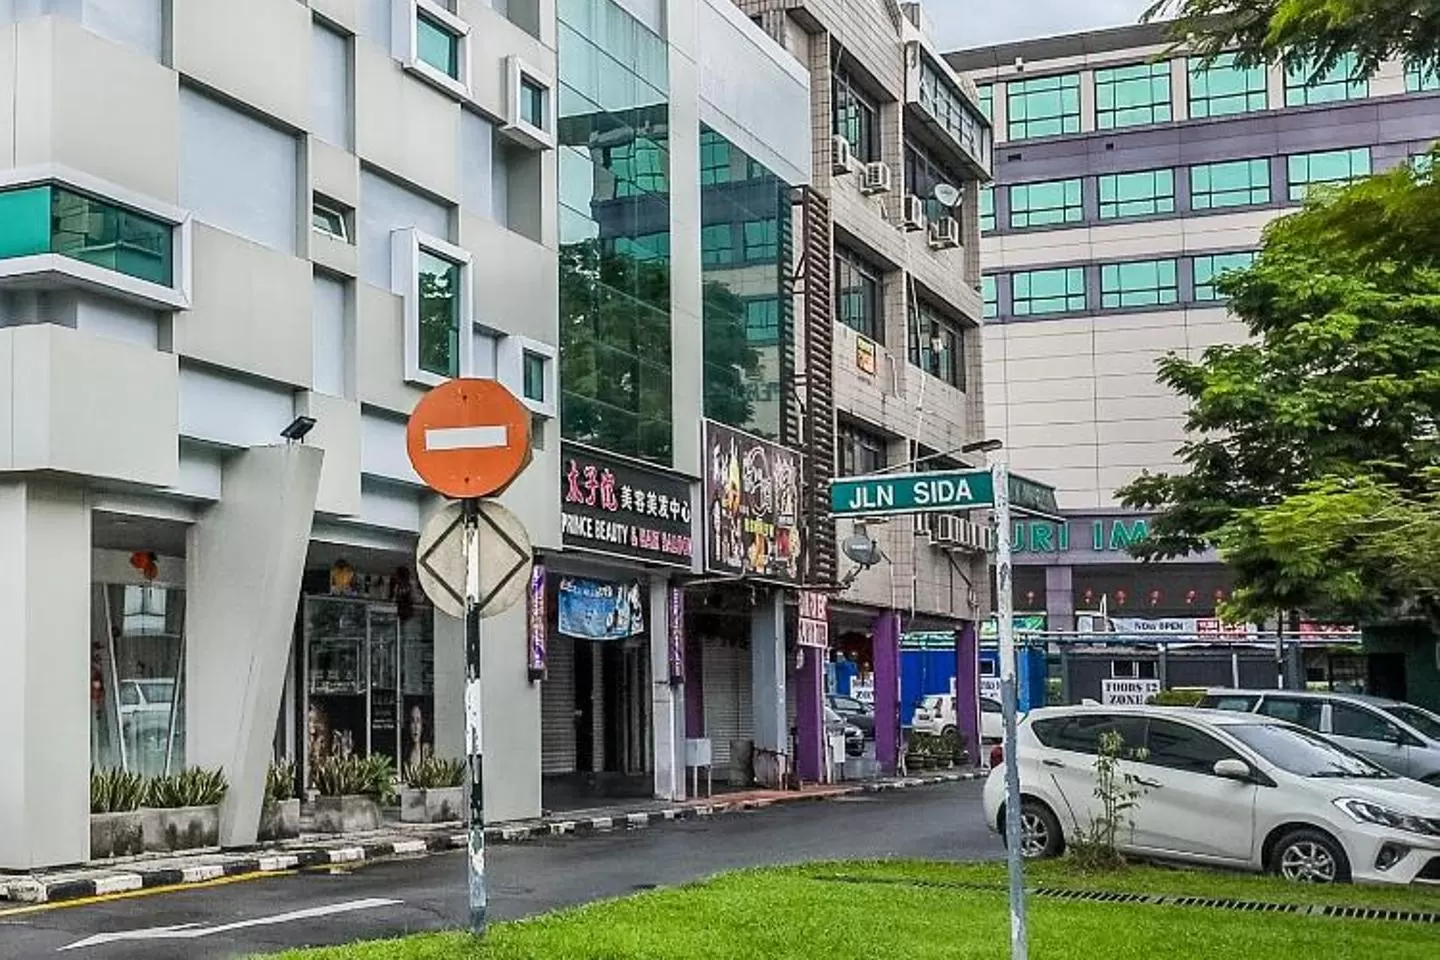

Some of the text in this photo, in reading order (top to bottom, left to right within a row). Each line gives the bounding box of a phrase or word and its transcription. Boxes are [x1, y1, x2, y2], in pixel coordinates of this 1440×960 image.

[849, 478, 974, 510] JLN SIDA
[561, 512, 593, 539] PRINCE
[595, 519, 629, 544] BEAUTY
